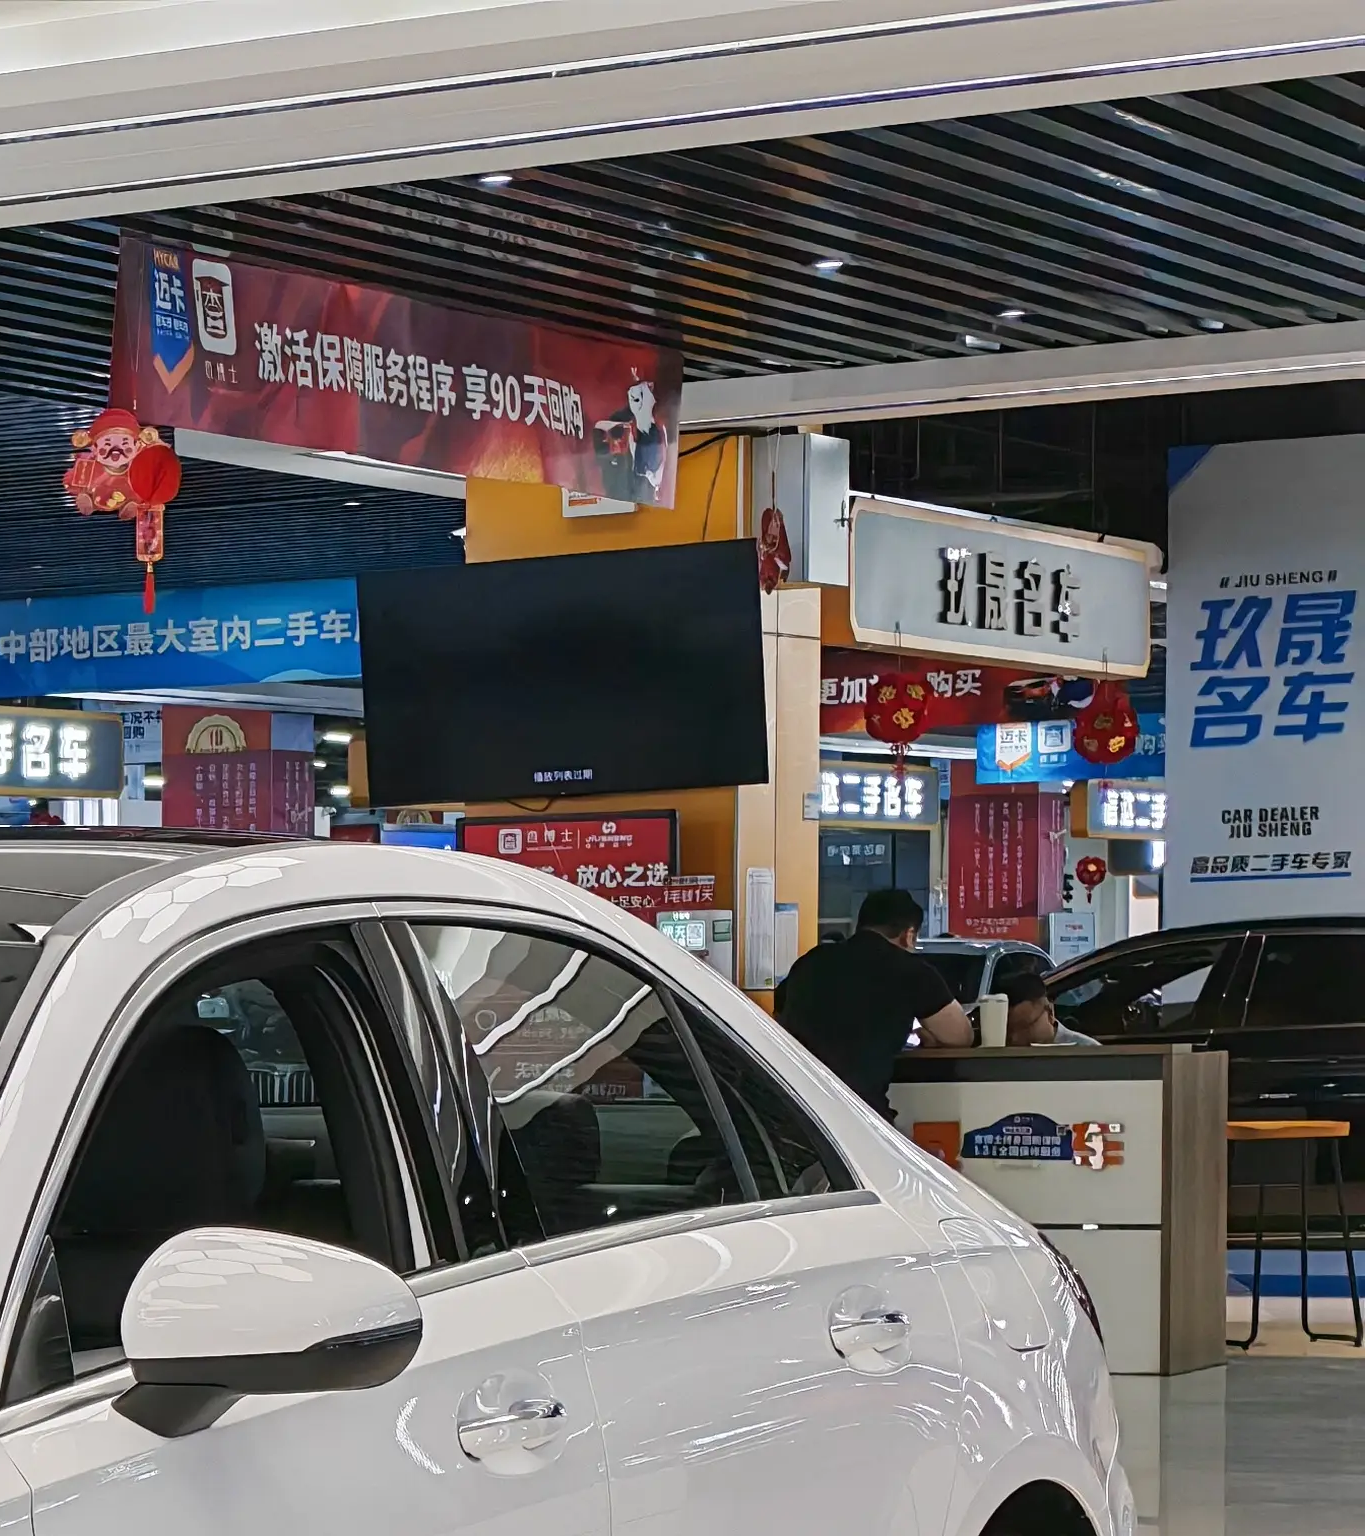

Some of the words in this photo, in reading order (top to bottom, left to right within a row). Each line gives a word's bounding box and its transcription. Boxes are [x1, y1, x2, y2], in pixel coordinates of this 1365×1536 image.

[154, 268, 186, 313] 迈卡
[253, 320, 457, 417] 激活保障服务程序
[462, 363, 586, 442] 享90天回购
[940, 546, 1082, 643] 玖晟名车
[1235, 574, 1260, 588] JIU
[1265, 570, 1324, 586] SHENG
[1190, 589, 1357, 671] 玖晟
[820, 669, 983, 704] 更加购买
[1189, 671, 1355, 749] 名车
[1000, 730, 1028, 743] 迈卡
[1221, 808, 1252, 824] CAR
[1258, 806, 1320, 823] DEALER
[1229, 823, 1253, 839] JIU
[1257, 821, 1312, 838] SHENG
[576, 862, 670, 889] 放心之选
[1190, 850, 1352, 875] 高品质二手车专家
